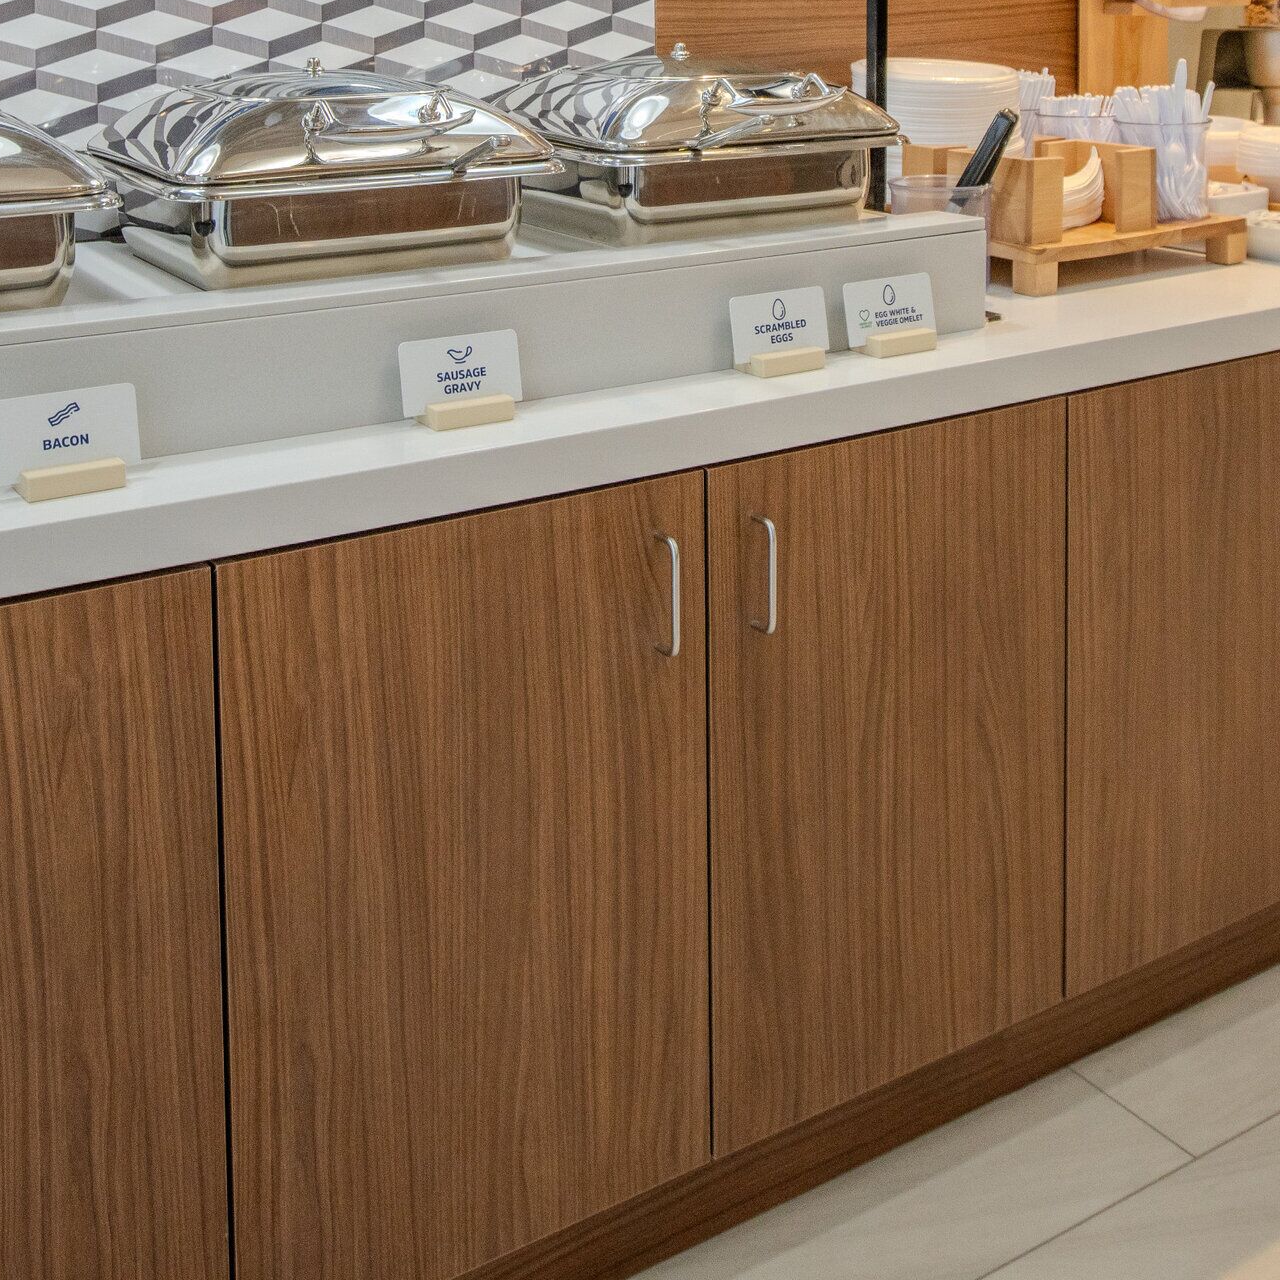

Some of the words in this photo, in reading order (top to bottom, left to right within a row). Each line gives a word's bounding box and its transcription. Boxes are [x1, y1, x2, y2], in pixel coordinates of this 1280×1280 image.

[874, 310, 888, 319] EGG
[889, 307, 909, 316] WHITE
[910, 306, 916, 314] &
[875, 319, 899, 327] VEGGIE
[899, 313, 923, 324] OMELET
[754, 319, 807, 335] SCRAMBLED
[770, 332, 794, 344] EGGS
[436, 366, 487, 383] SAUSAGE
[444, 380, 481, 395] GRAVY
[42, 433, 89, 451] BACON
